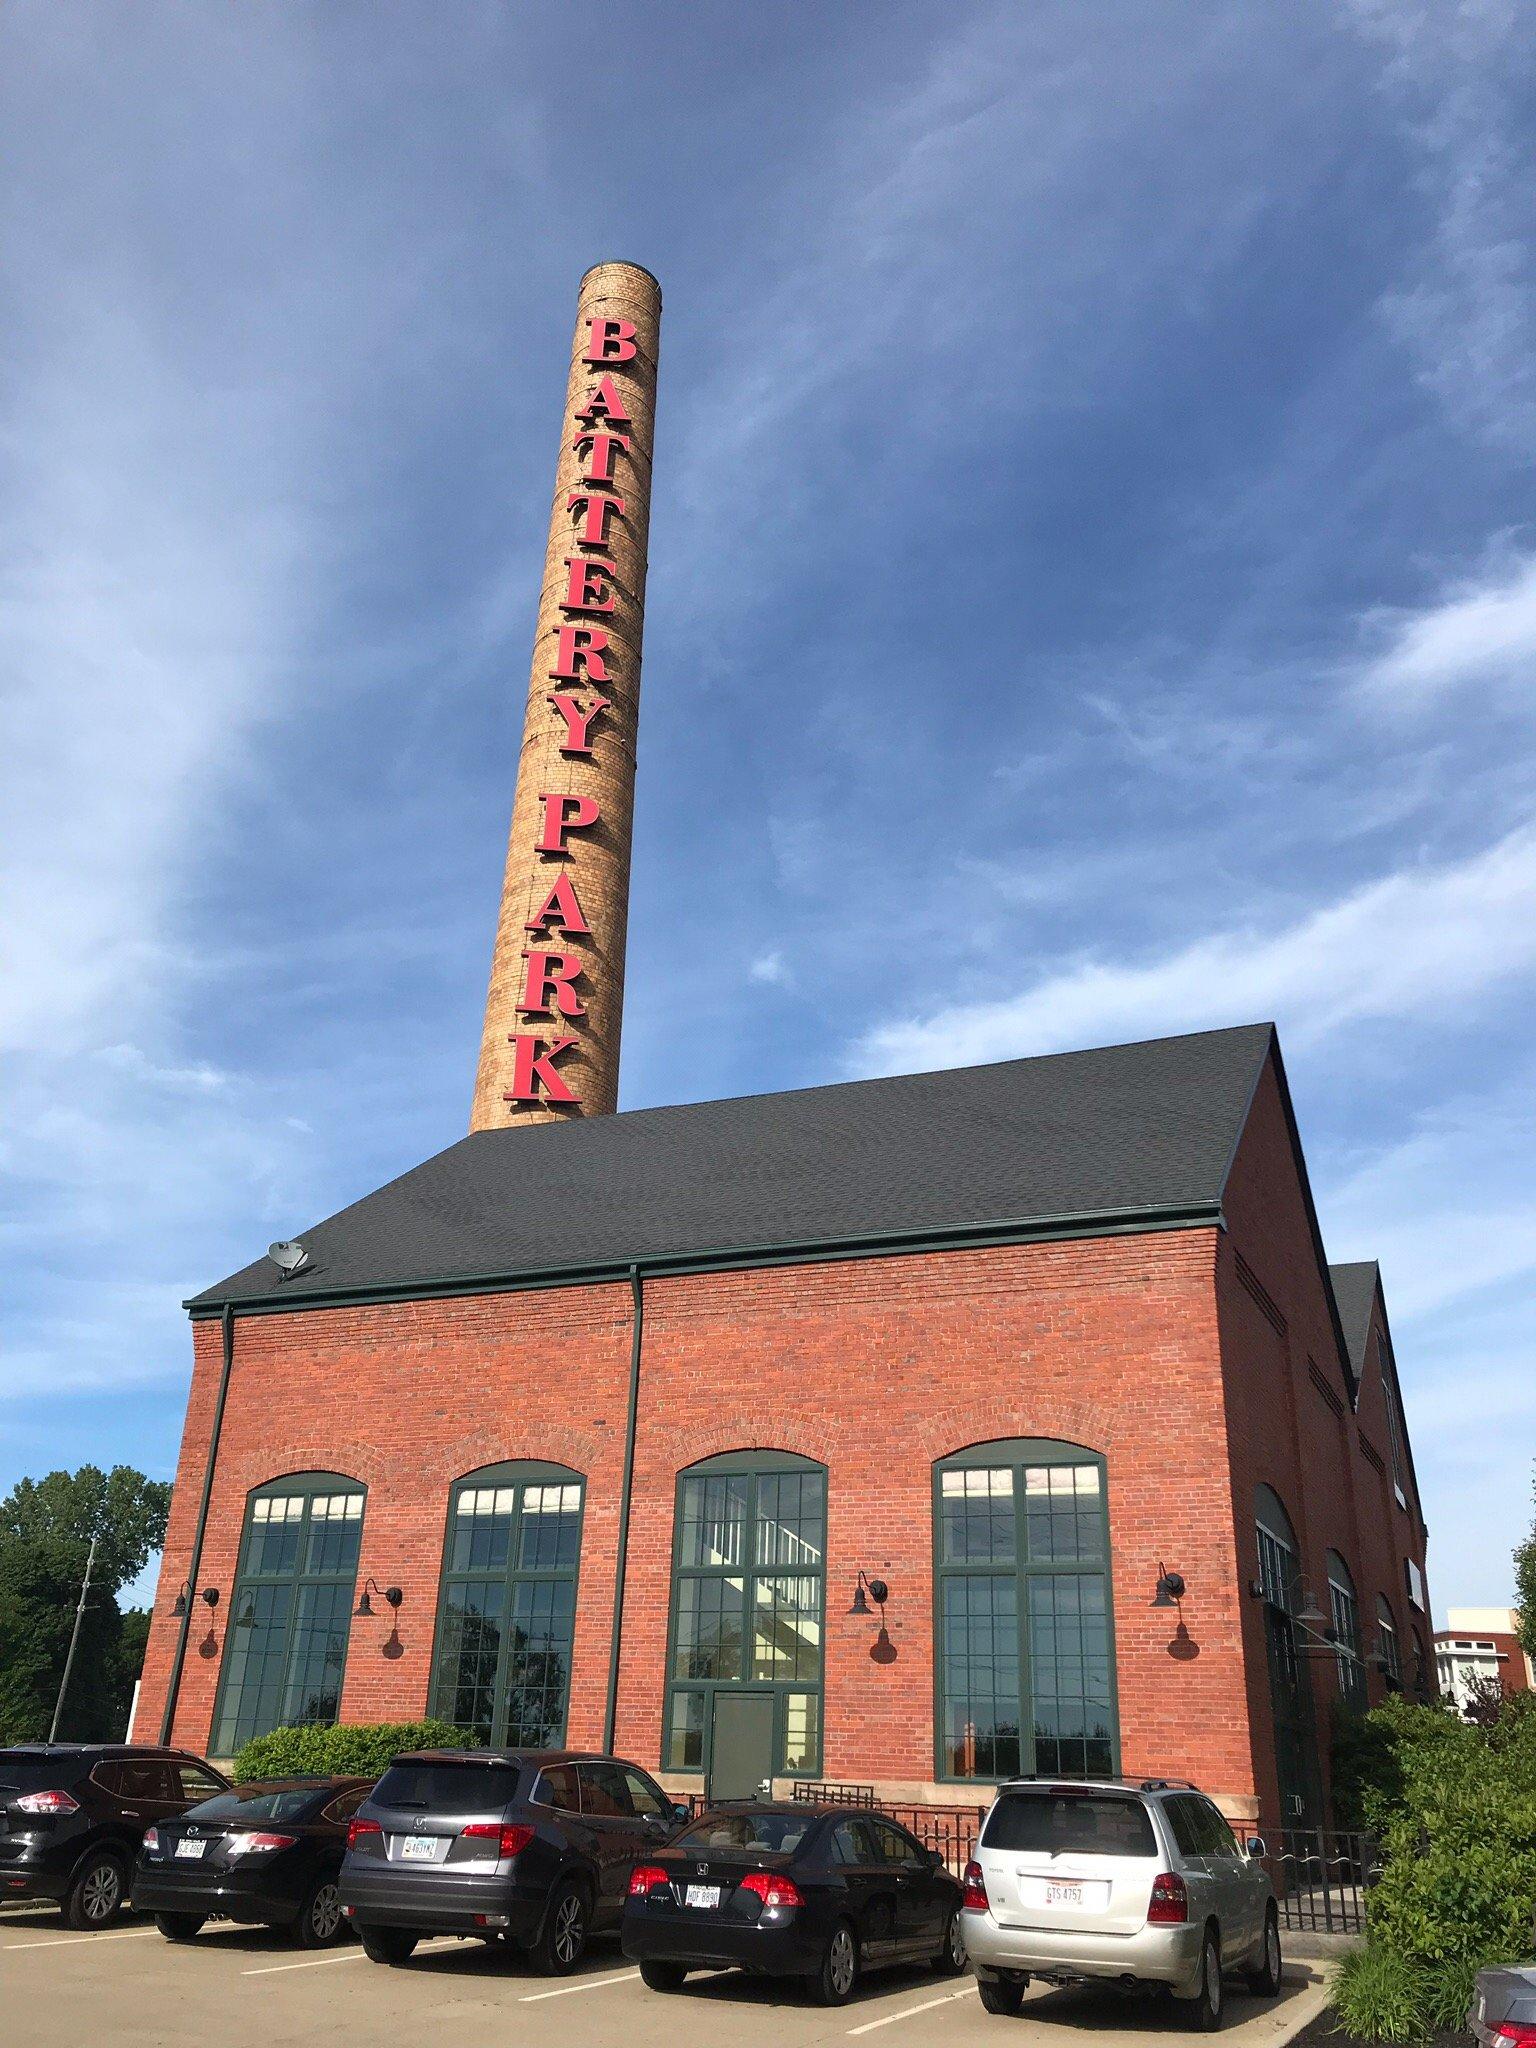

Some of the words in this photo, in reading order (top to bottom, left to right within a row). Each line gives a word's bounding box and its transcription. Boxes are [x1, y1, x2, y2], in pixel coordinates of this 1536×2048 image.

[546, 317, 638, 755] BATTERY
[502, 792, 600, 1104] PARK
[1046, 1886, 1062, 1899] GTS
